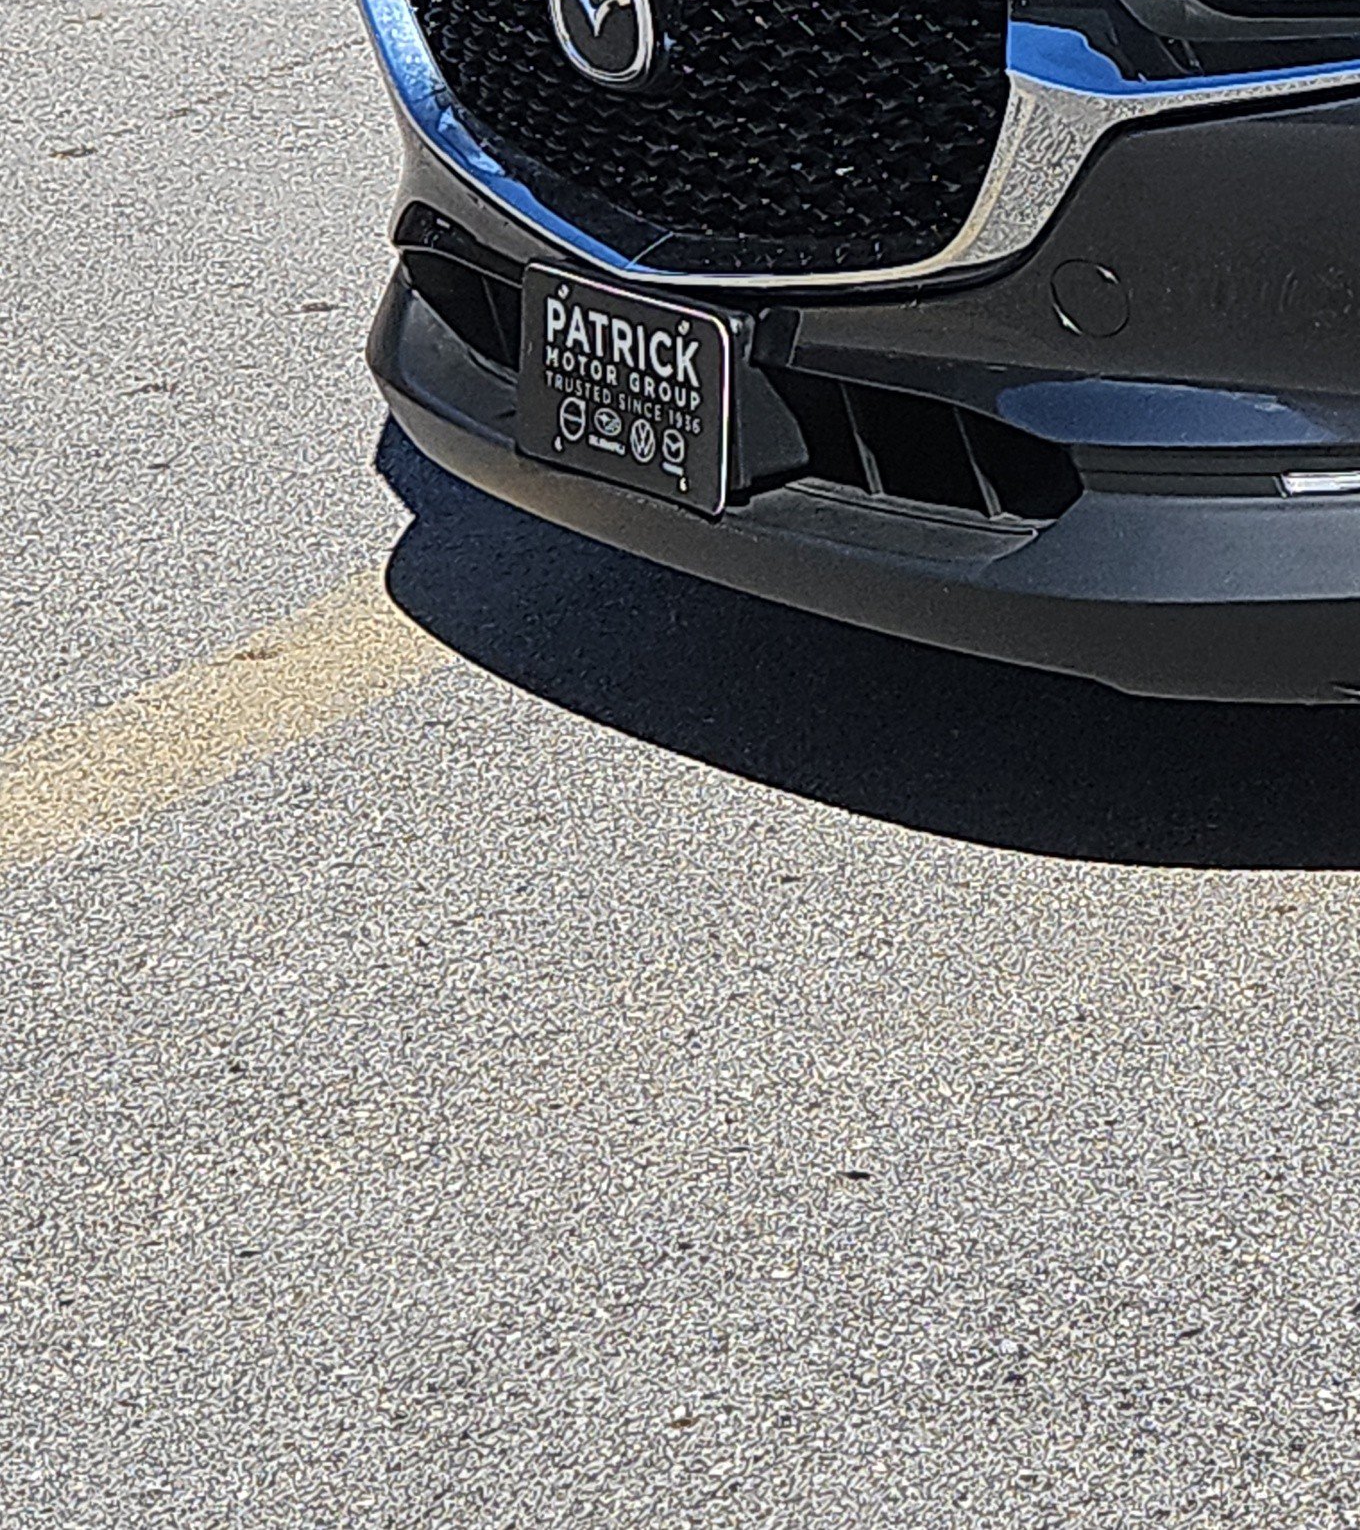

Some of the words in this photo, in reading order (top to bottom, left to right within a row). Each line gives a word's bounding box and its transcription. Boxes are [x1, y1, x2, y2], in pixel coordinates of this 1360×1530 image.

[546, 297, 699, 387] PATRICK
[545, 345, 618, 386] MOTOR
[628, 372, 701, 410] GROUP
[545, 371, 612, 405] TRUSTED
[618, 393, 662, 421] SINCE
